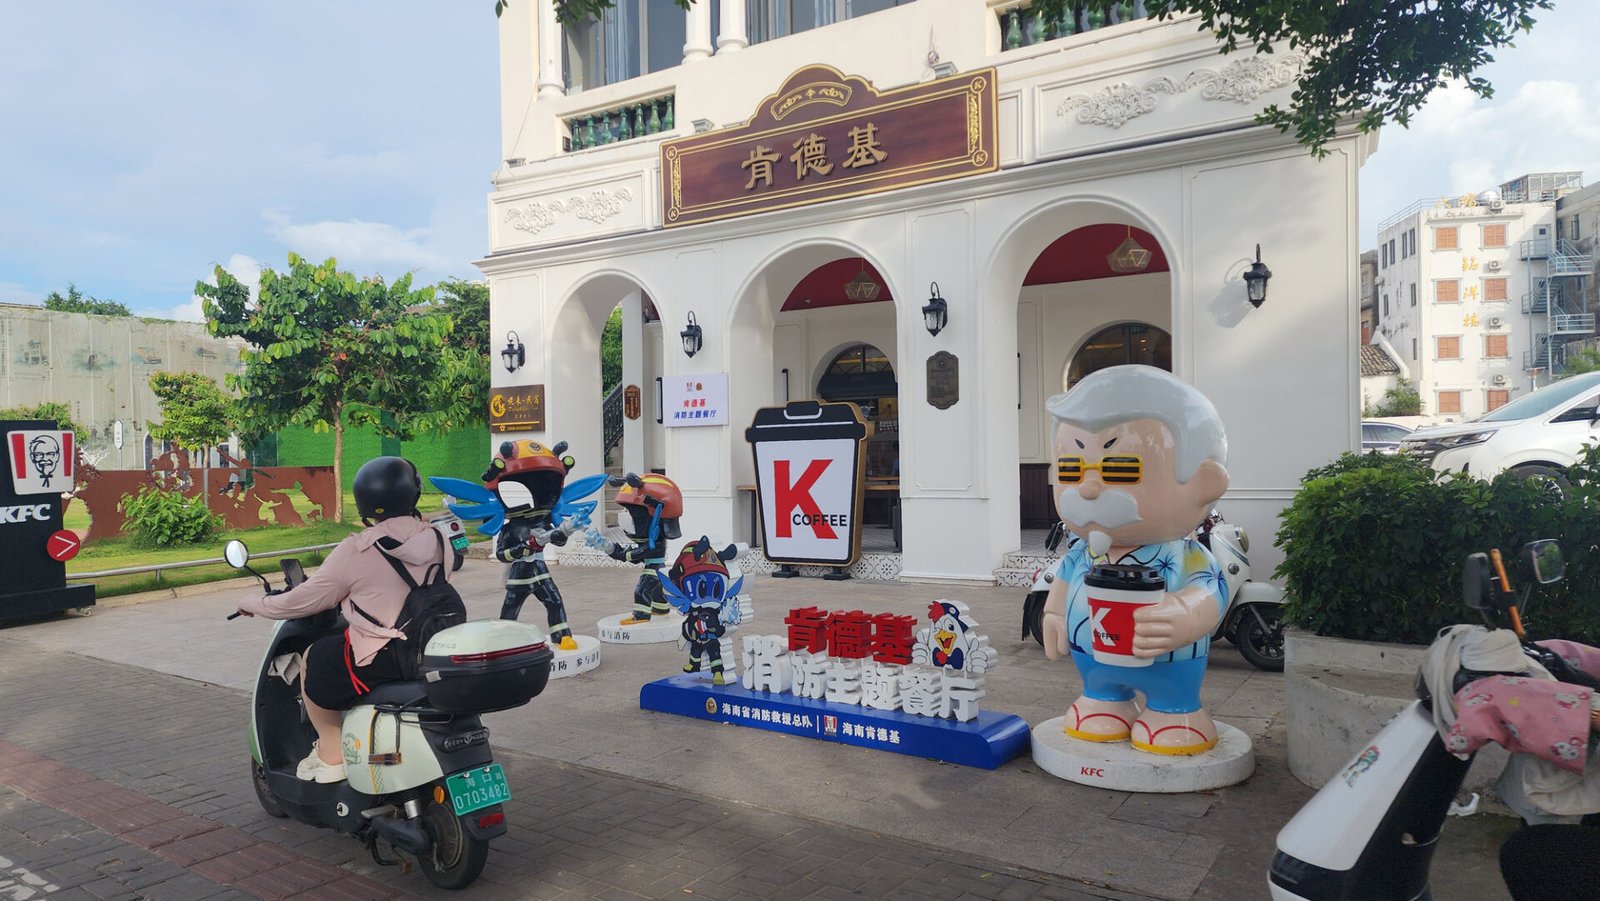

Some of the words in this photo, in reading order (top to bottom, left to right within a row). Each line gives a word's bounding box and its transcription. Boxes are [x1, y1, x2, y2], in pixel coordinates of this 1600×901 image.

[741, 121, 889, 192] 肯德基
[673, 409, 717, 419] 消防主题餐厅
[682, 398, 706, 408] 肯德基
[773, 458, 839, 540] K
[0, 503, 51, 524] KFC
[792, 513, 848, 527] COFFEE
[601, 629, 631, 642] 参与消防
[784, 606, 918, 664] 肯德基
[742, 634, 985, 722] 消防主题餐厅
[721, 702, 813, 729] 海南省消防救援总队
[842, 721, 901, 745] 海南肯德基
[1080, 766, 1105, 779] KFC
[454, 783, 509, 810] 0703482
